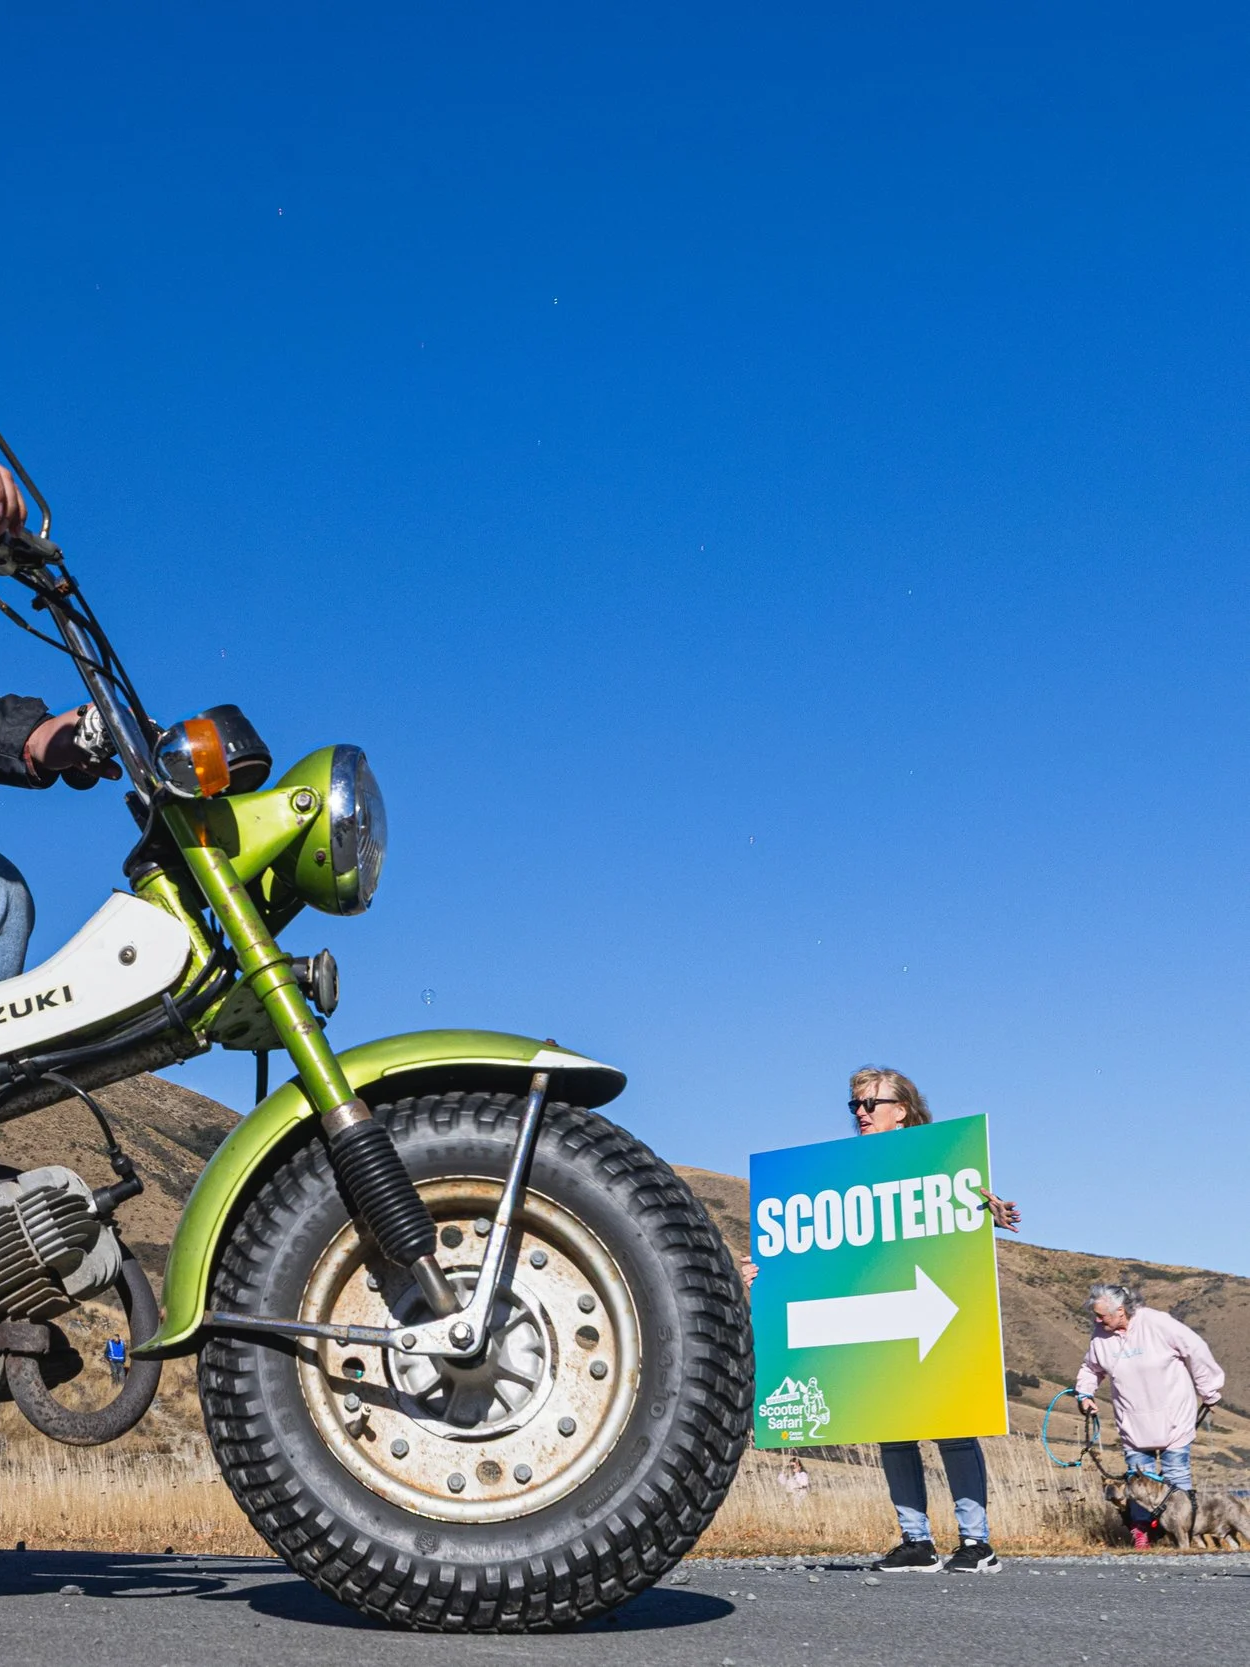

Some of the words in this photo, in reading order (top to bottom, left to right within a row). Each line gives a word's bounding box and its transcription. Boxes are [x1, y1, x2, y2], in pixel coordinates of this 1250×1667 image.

[756, 1168, 986, 1258] SCOOTERS
[758, 1404, 805, 1417] Scooter
[768, 1415, 803, 1429] Safari
